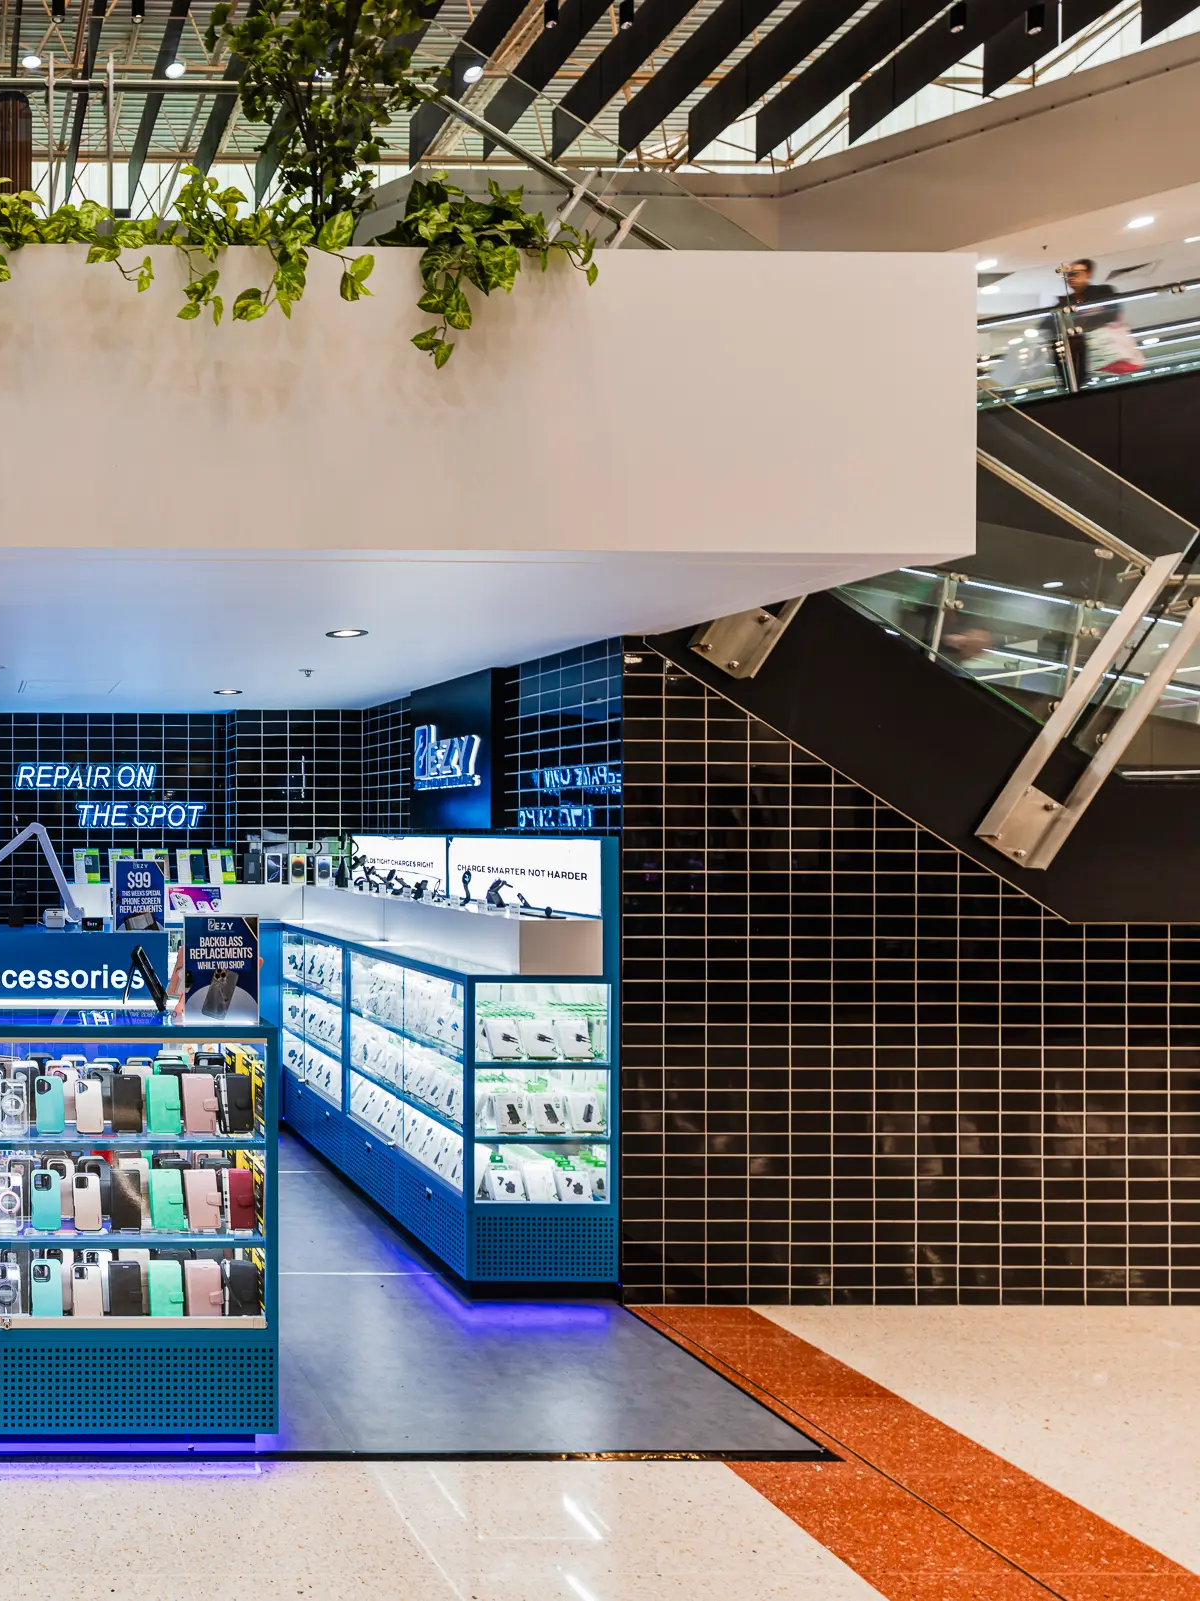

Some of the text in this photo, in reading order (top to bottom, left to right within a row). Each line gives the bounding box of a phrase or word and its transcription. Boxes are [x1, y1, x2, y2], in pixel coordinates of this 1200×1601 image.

[17, 765, 154, 788] REPAIR ON
[78, 804, 204, 826] THE SPOT
[391, 859, 416, 868] CHARGES
[417, 861, 434, 869] RIGHT
[457, 863, 588, 881] CHARGE SMARTER NOT HARDER
[127, 871, 151, 889] $99
[141, 897, 161, 905] SCREEN
[119, 905, 162, 914] REPLACEMENTS
[199, 936, 243, 947] BACKGLASS
[189, 947, 253, 960] REPLACEMENTS
[197, 960, 245, 970] WHILE YOU SHOP
